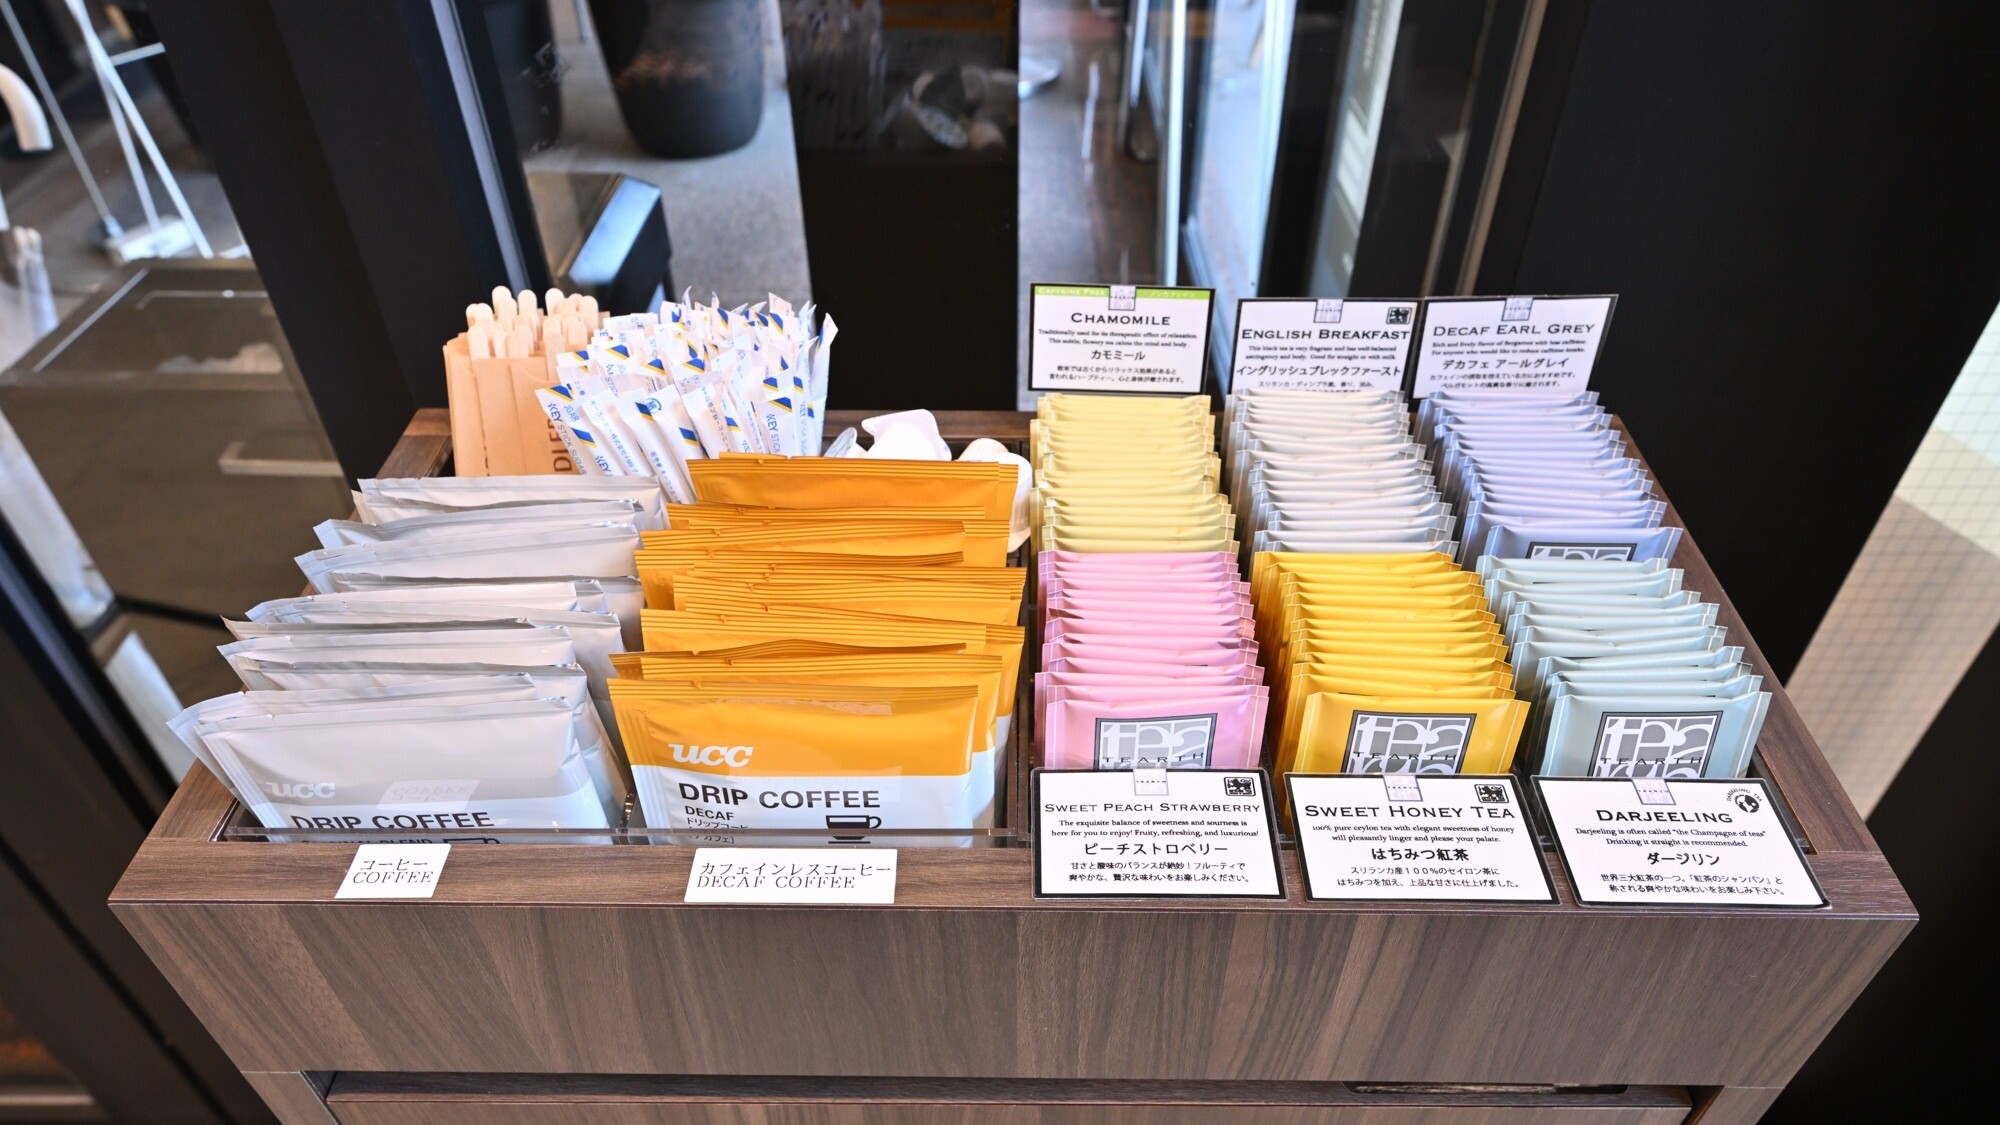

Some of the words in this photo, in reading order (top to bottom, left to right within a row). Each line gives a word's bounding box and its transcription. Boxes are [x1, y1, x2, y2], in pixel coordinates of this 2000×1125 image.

[1038, 287, 1083, 296] CAFFEINE
[1084, 287, 1106, 296] FREE
[1071, 312, 1171, 326] CHAMOMILE
[1038, 328, 1075, 337] Traditionally
[1108, 330, 1142, 339] therapeutic
[1241, 328, 1312, 340] ENGLISH
[1318, 329, 1410, 340] BREAKFAST
[1433, 326, 1490, 337] DECAF
[1496, 324, 1541, 335] EARL
[1547, 323, 1595, 334] GREY
[1081, 338, 1104, 346] flowery
[1172, 341, 1189, 349] body.
[1308, 345, 1333, 353] fragrant
[1503, 339, 1534, 347] Bergamot
[1091, 350, 1146, 361] カモミール
[1244, 353, 1279, 361] astringency
[1336, 353, 1359, 361] straight
[1442, 359, 1490, 370] デカフェ
[1495, 357, 1570, 369] アールグレイ
[1236, 365, 1401, 377] イングリッシュブレックファースト
[766, 413, 778, 431] KEY
[547, 403, 563, 423] KEY
[557, 424, 574, 447] STICK
[570, 448, 587, 475] SUGAR
[595, 455, 612, 473] KEY
[1102, 752, 1204, 763] TEARTH
[1353, 751, 1457, 761] TEARTH
[1599, 756, 1703, 765] TEARTH
[678, 782, 749, 806] DRIP
[758, 790, 881, 809] COFFEE
[684, 805, 735, 822] DECAF
[1044, 803, 1098, 813] SWEET
[1103, 803, 1153, 812] PEACH
[1159, 803, 1260, 813] STRAWBERRY
[1305, 805, 1380, 817] SWEET
[1389, 805, 1463, 818] HONEY
[1470, 806, 1516, 819] TEA
[290, 815, 362, 829] DRIP
[371, 812, 495, 829] COFFEE
[1596, 810, 1733, 824] DARJEELING
[1075, 819, 1110, 828] exquisite
[1333, 825, 1352, 833] pure
[1352, 824, 1379, 833] ceylon
[1411, 824, 1441, 833] elegant
[1489, 825, 1514, 835] honey
[1083, 830, 1098, 838] you
[1109, 829, 1133, 838] enjoy!
[1134, 828, 1160, 838] Fruity,
[1160, 828, 1203, 838] refreshing,
[1574, 827, 1618, 836] Darjeeling
[1625, 827, 1647, 835] often
[1689, 828, 1738, 838] Champagne
[1738, 829, 1747, 837] of
[1347, 834, 1387, 843] pleasantly
[1387, 834, 1412, 843] linger
[1429, 834, 1454, 843] please
[1455, 836, 1474, 844] your
[1474, 835, 1500, 844] palate.
[1605, 837, 1643, 847] Drinking
[1650, 838, 1682, 847] straight
[1690, 839, 1749, 847] recommended.
[1084, 842, 1228, 856] ピーチストロベリー
[1370, 847, 1470, 862] はちみつ紅茶
[360, 858, 428, 871] コーヒー
[1646, 852, 1720, 866] ダージリン
[699, 862, 891, 876] カフェインレスコーヒー
[352, 871, 434, 884] COFFEE
[696, 875, 766, 888] DECAF
[774, 875, 856, 889] COFFEE
[1068, 872, 1250, 883] 爽やかな、贅沢な味わいをお楽しみください。
[1336, 878, 1520, 888] はちみつを加え、上品な甘さに仕上げました。
